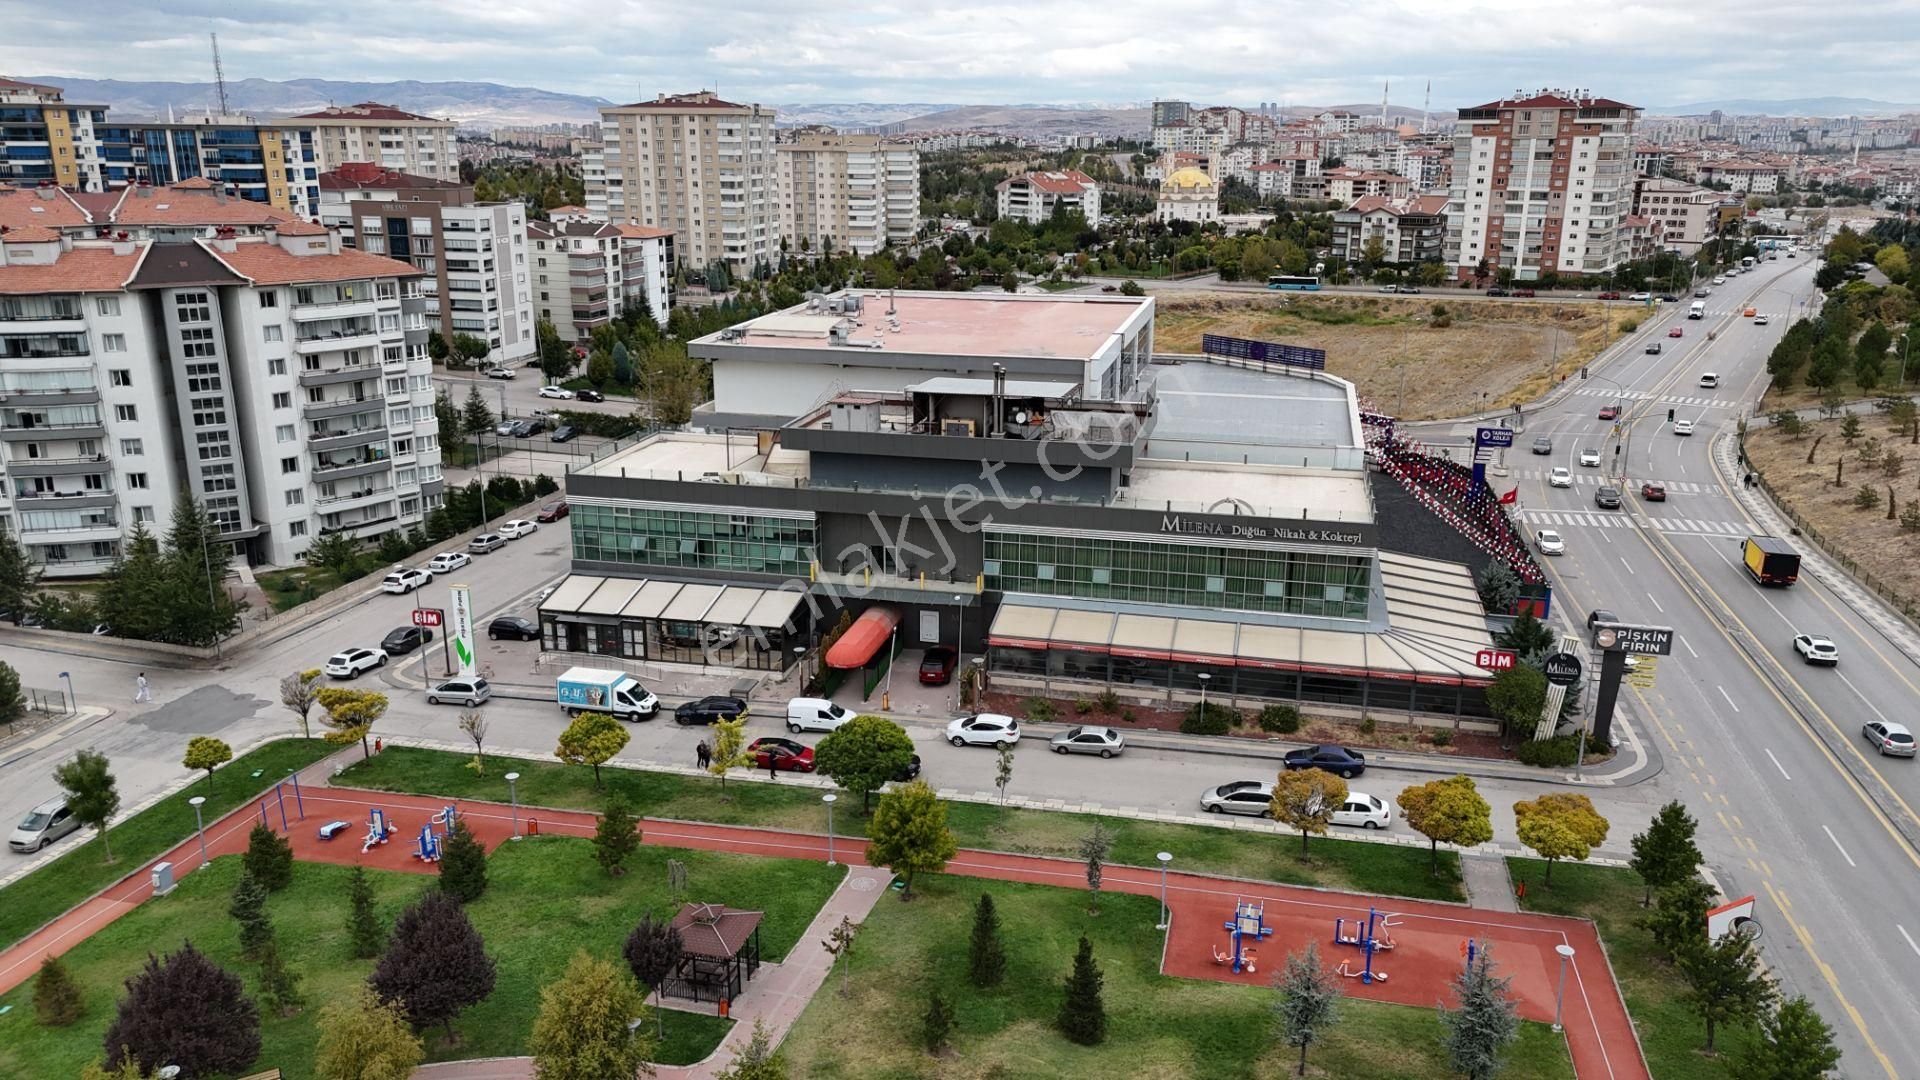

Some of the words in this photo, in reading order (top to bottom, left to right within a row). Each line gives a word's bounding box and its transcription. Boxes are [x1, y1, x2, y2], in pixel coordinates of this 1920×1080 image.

[1231, 525, 1267, 538] Düğün
[1273, 527, 1306, 540] Nikah
[1308, 531, 1318, 540] &
[1320, 530, 1362, 545] Kokteyl
[1617, 629, 1668, 642] PİŞKİN
[1621, 641, 1660, 653] FIRIN
[1479, 651, 1511, 668] BİM
